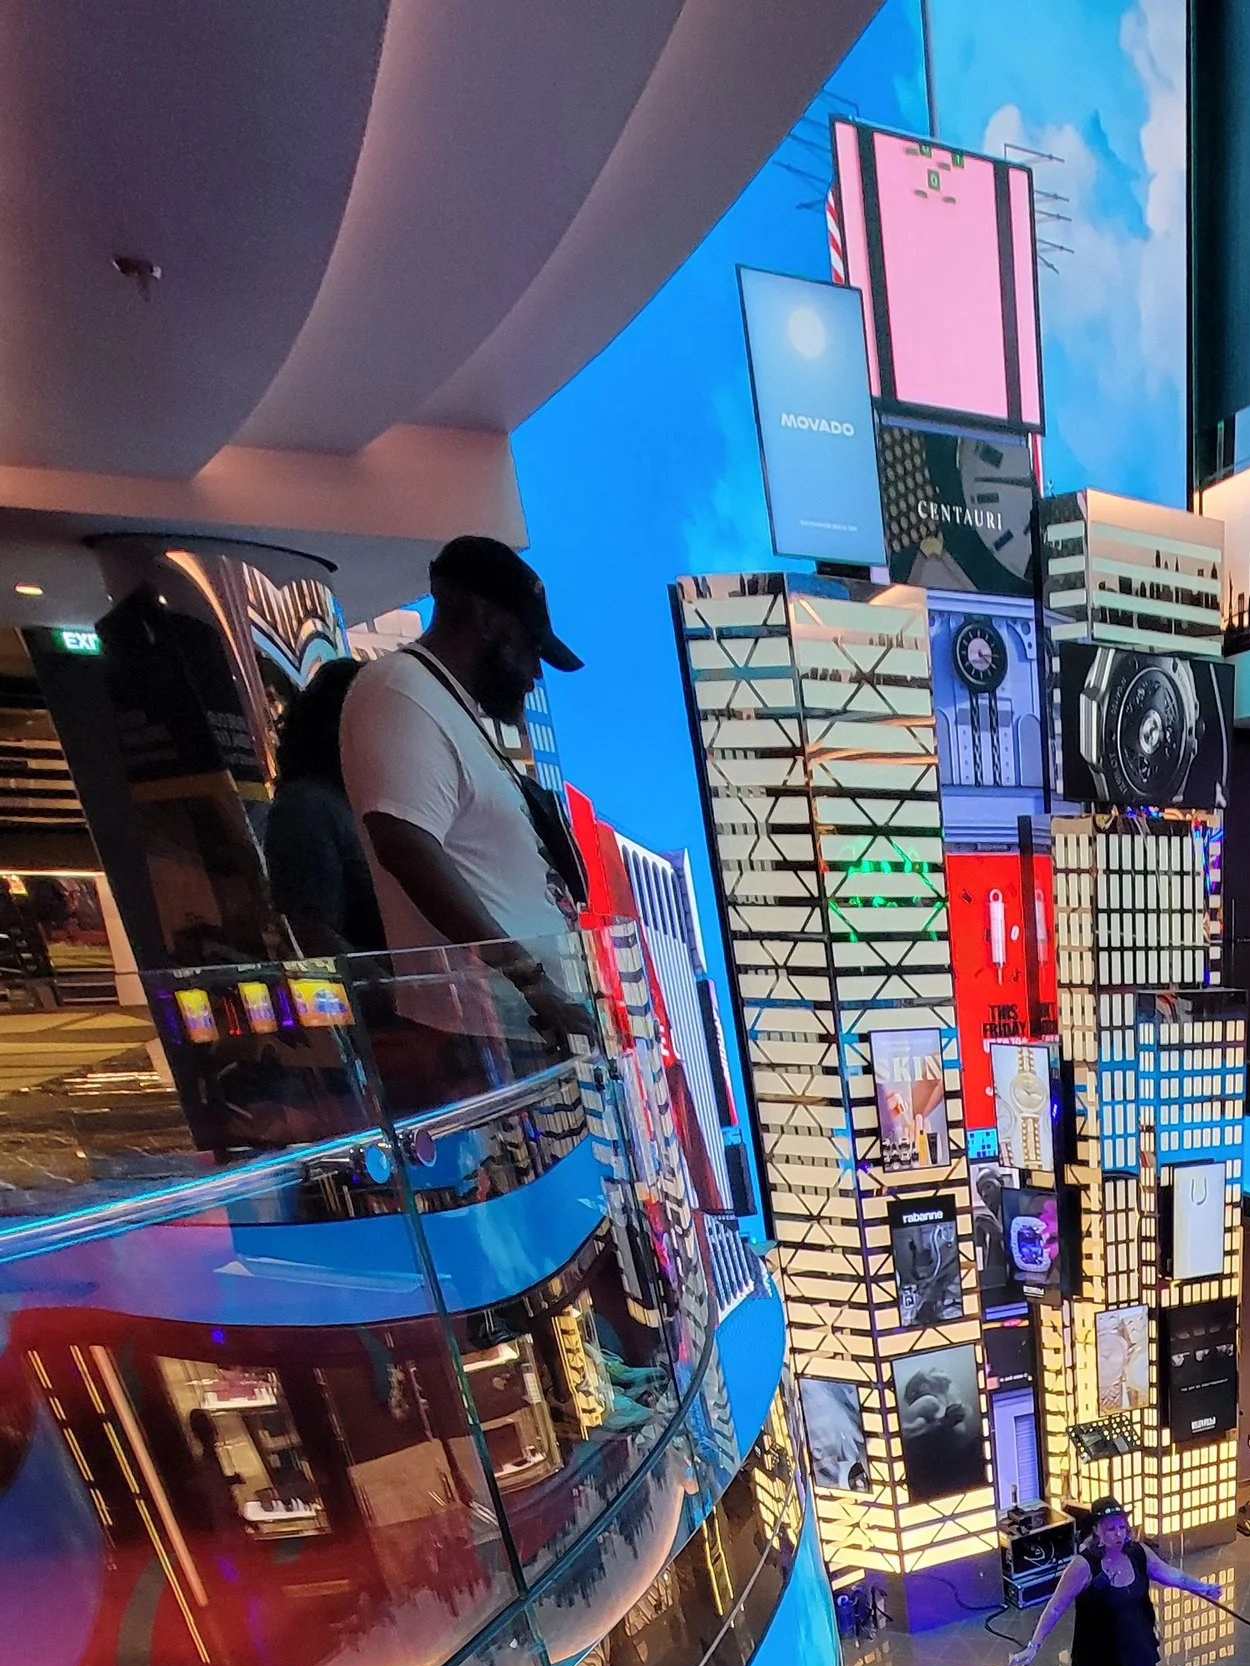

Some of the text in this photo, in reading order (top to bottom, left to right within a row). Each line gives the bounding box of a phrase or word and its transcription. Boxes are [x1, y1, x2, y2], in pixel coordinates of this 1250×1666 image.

[780, 412, 855, 437] MOVADO
[916, 499, 1003, 531] CENTAURI
[988, 1004, 1018, 1020] THIS
[982, 1022, 1026, 1039] FRIDAY
[875, 1055, 942, 1083] SKIN
[902, 1210, 944, 1224] rabanne
